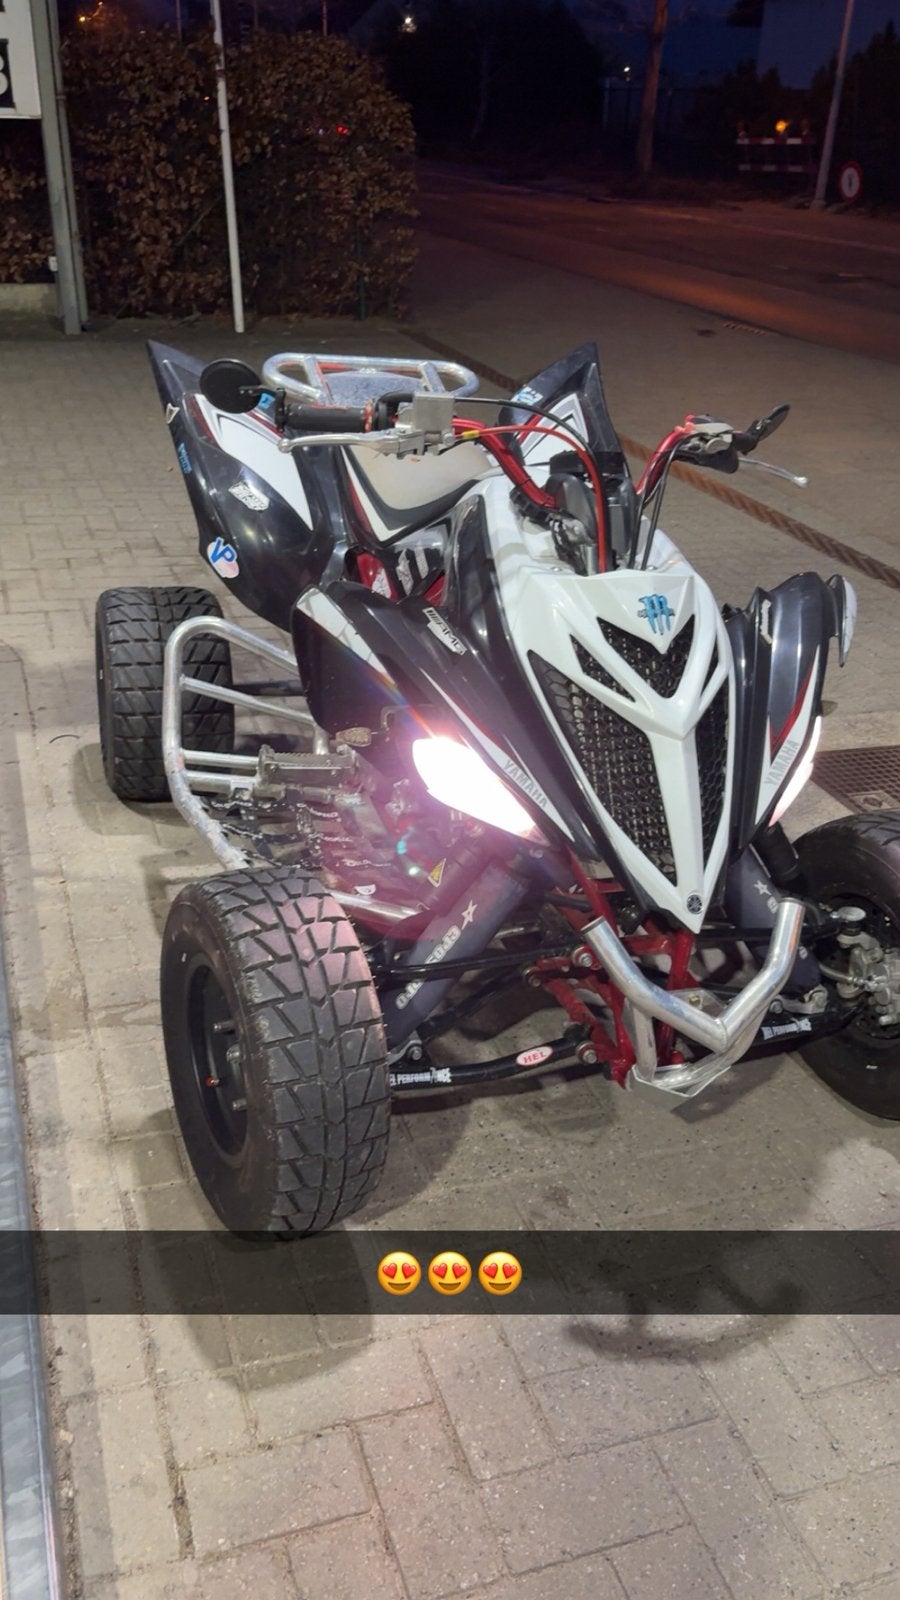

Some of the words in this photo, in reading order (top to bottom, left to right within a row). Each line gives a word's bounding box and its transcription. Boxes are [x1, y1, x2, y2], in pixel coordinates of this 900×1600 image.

[210, 538, 236, 563] VP
[764, 740, 800, 785] YAMAHA
[504, 759, 547, 807] YAMAHA
[522, 1050, 546, 1064] HEL
